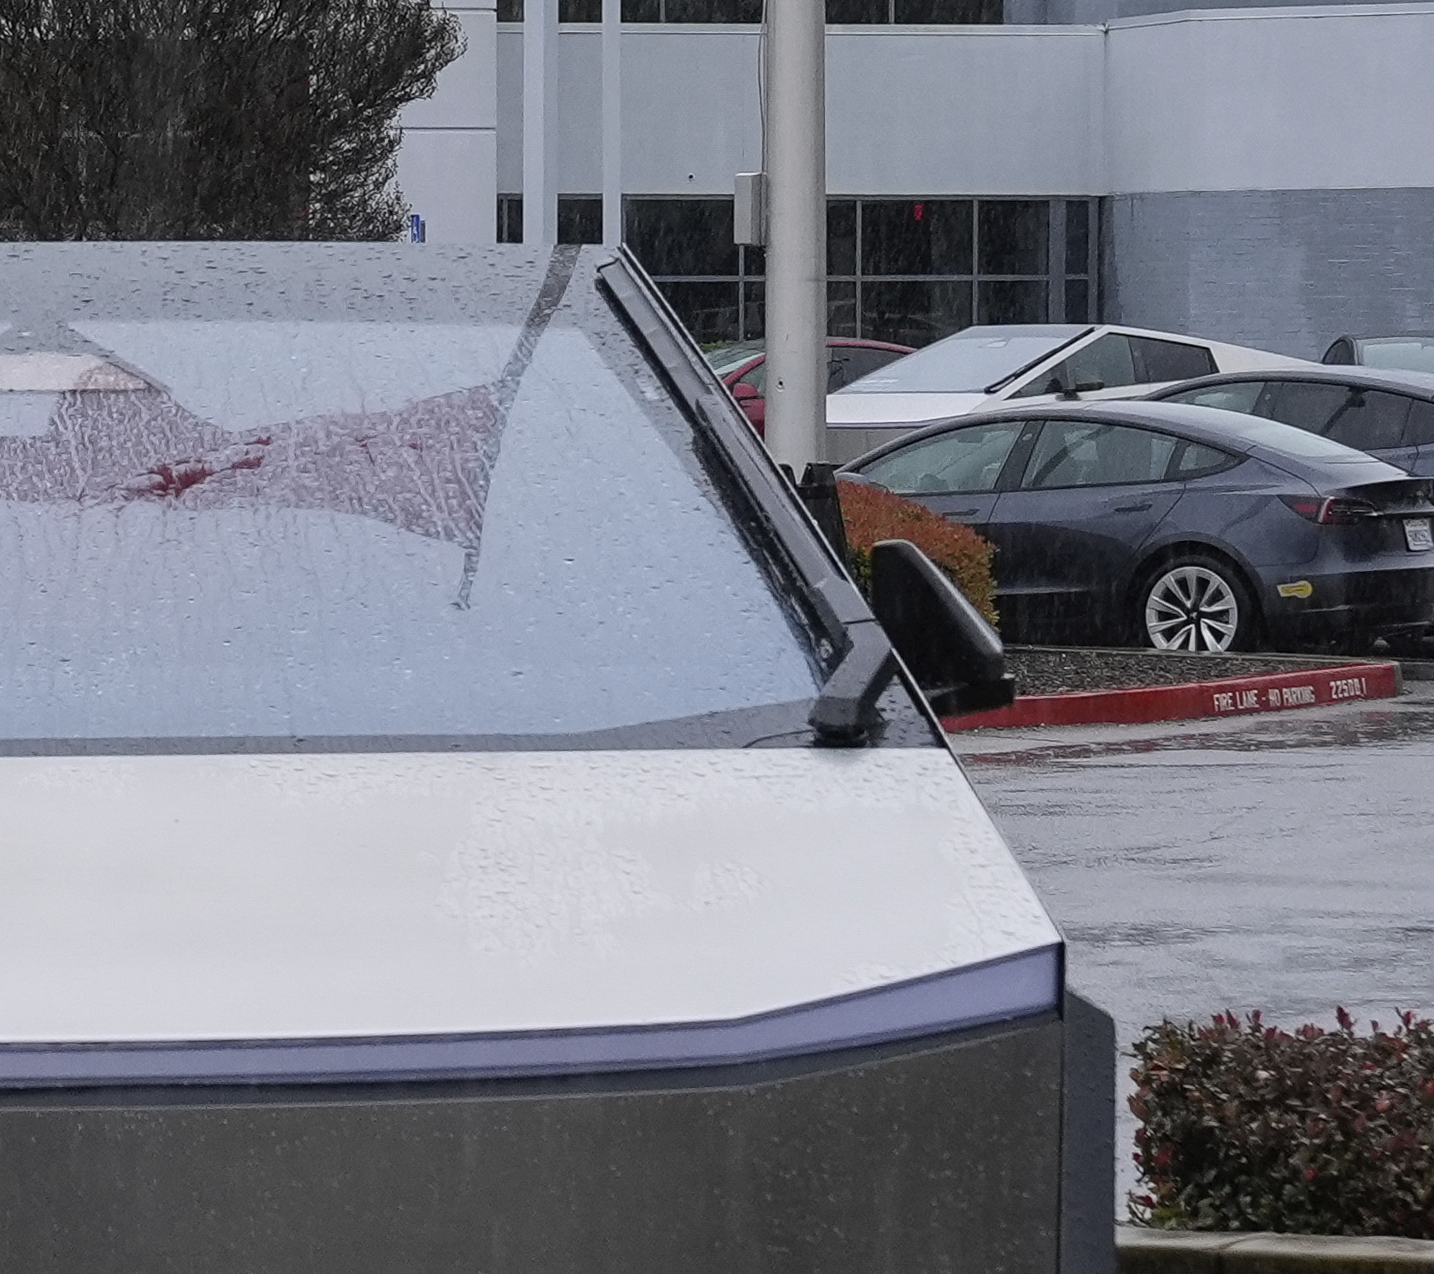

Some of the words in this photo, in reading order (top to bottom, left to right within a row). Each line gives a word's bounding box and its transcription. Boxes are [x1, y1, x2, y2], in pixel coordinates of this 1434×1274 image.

[1213, 692, 1235, 712] FIRE
[1235, 689, 1260, 709] LANE
[1268, 688, 1281, 708] NO
[1282, 685, 1316, 707] PARKING
